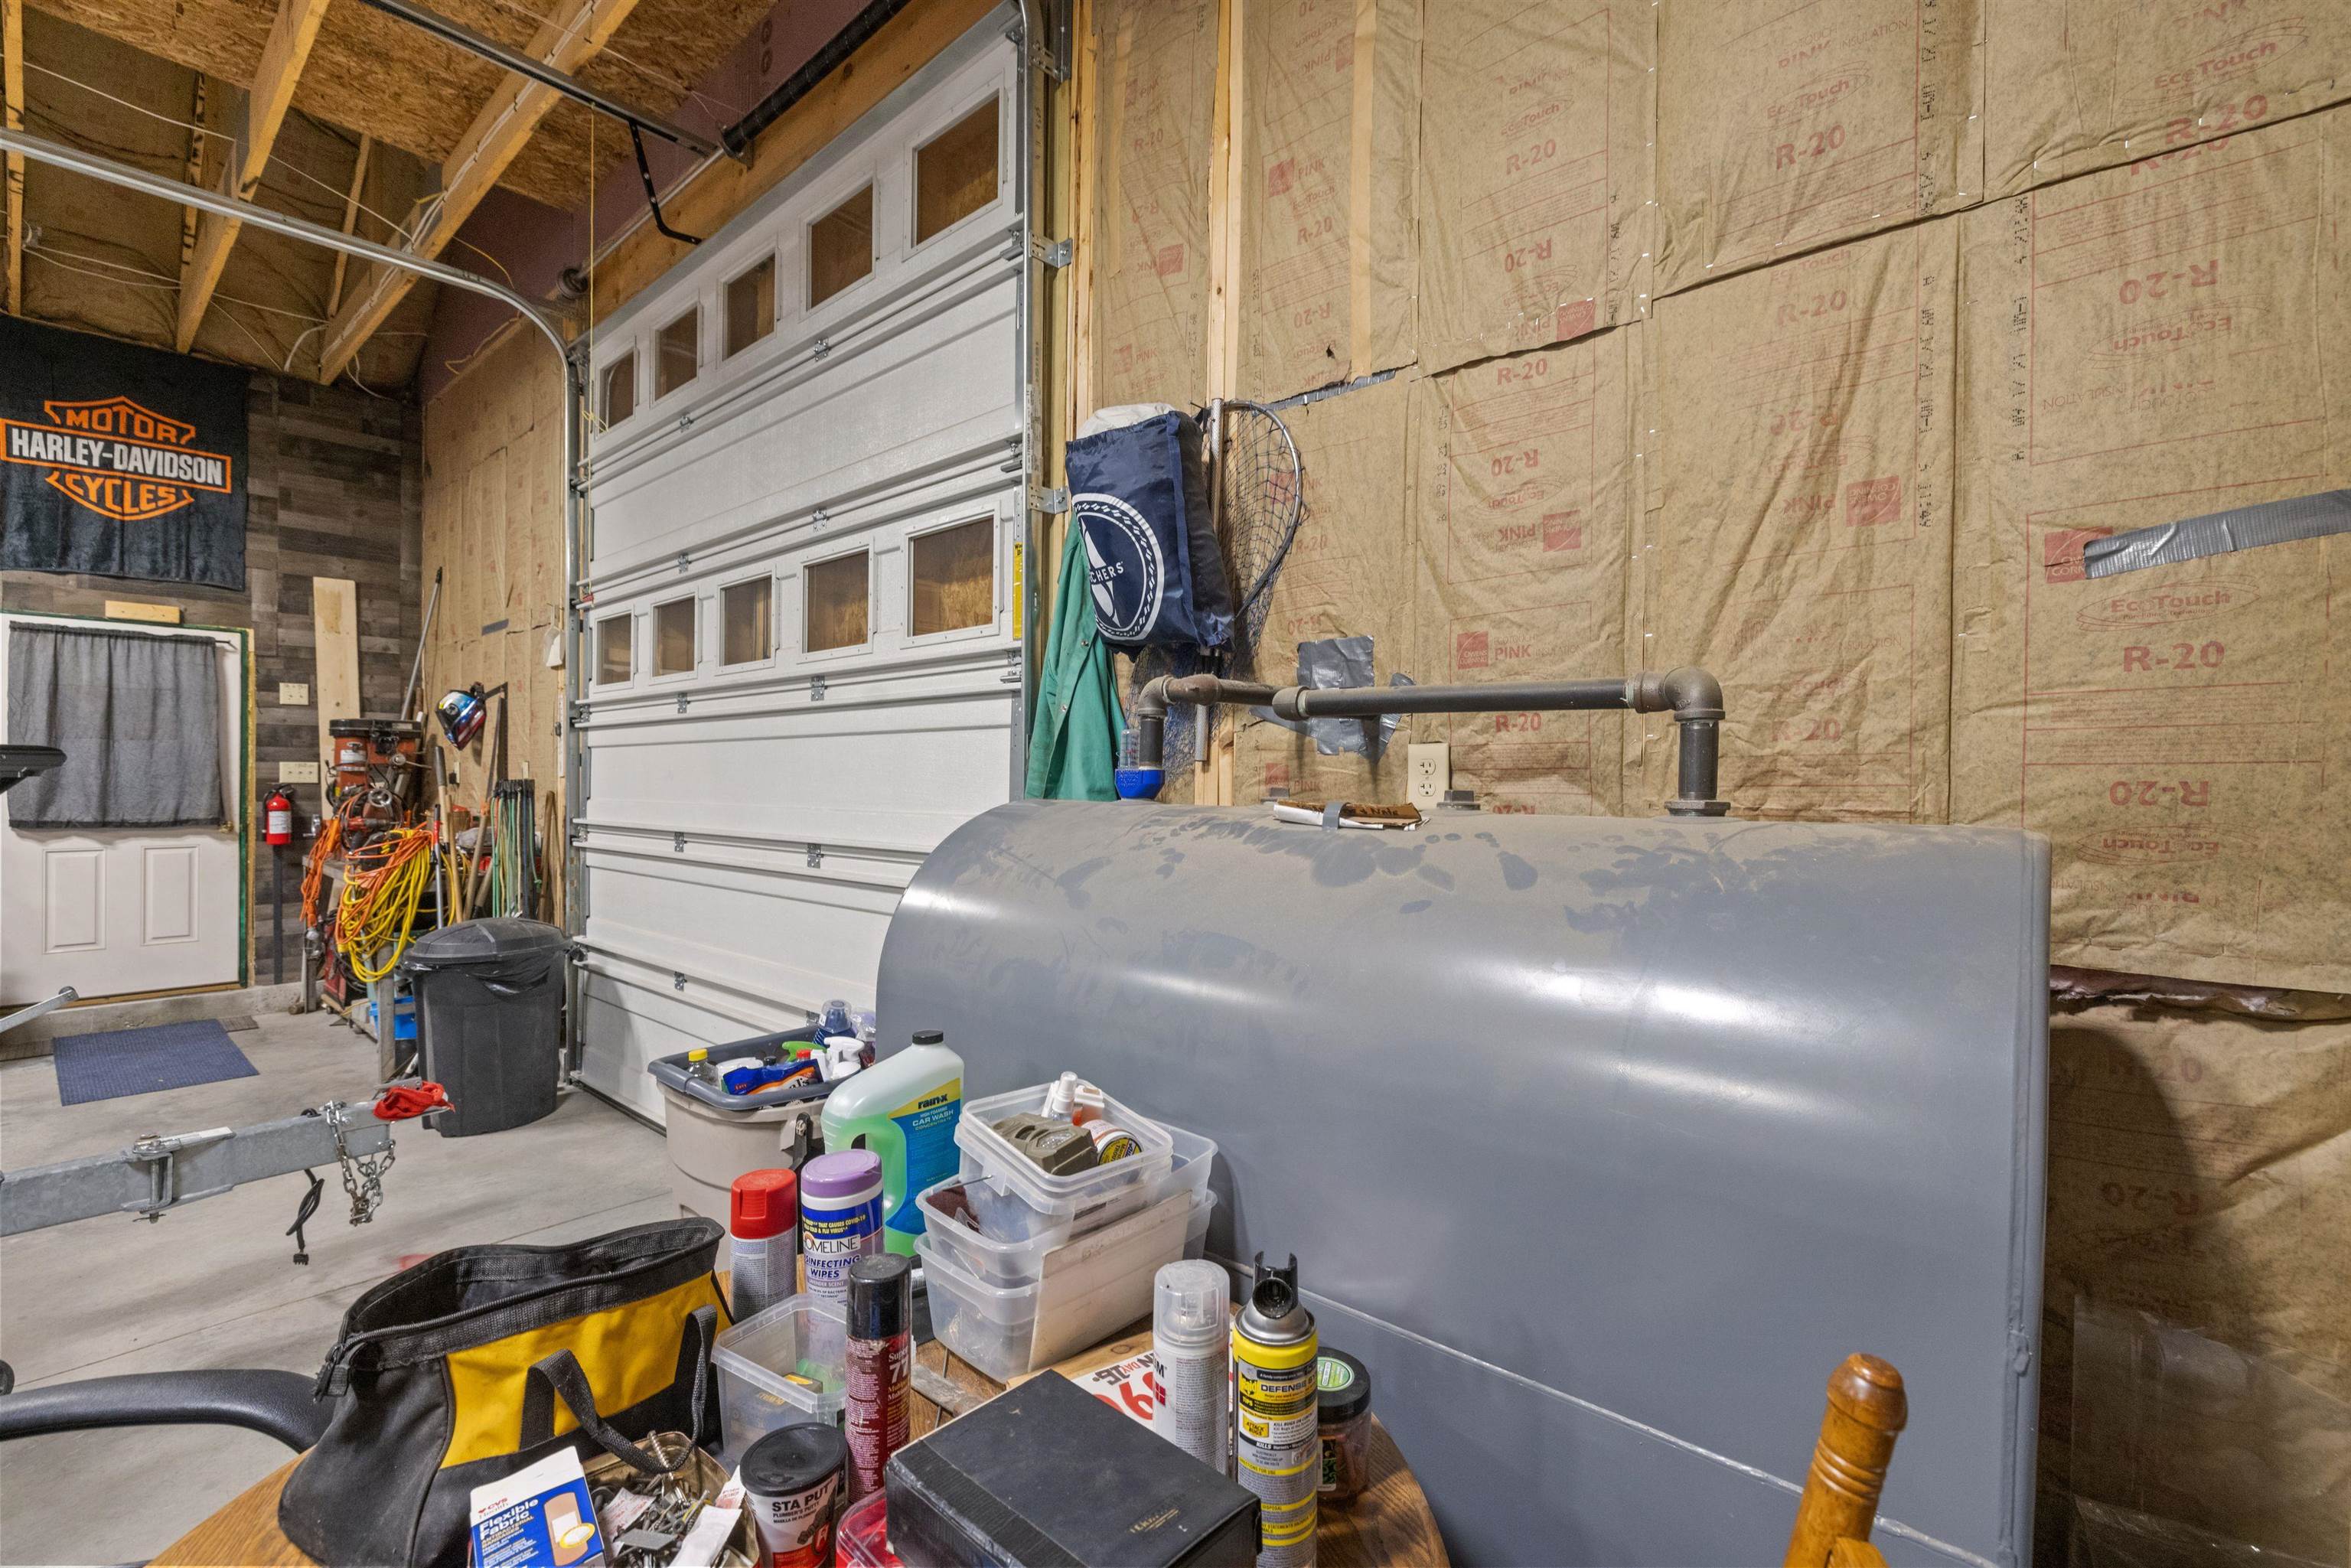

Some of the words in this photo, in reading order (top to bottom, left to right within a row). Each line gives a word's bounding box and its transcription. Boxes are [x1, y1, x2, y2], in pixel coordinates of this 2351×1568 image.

[2154, 42, 2278, 90] EcoTouch
[2165, 94, 2268, 144] R-20
[1506, 139, 1556, 175] R-20
[1776, 125, 1846, 170] R-20
[1296, 217, 1332, 246] R-20
[1505, 238, 1552, 273] R-20
[2118, 259, 2219, 305] R-20
[1294, 302, 1330, 328] R-20
[1777, 290, 1847, 327] R-20
[2114, 317, 2232, 351] EcoTouch
[1497, 358, 1547, 386] R-20
[66, 405, 177, 442] MOTOR
[11, 428, 222, 485] HARLEY-DAVIDSON
[1492, 449, 1538, 477] R-20
[65, 473, 176, 514] CYCLES
[1498, 523, 1535, 541] PINK
[1089, 562, 1123, 583] CHERS
[2111, 591, 2231, 613] EcoTouch
[1495, 644, 1531, 660] PINK
[2123, 641, 2225, 673] R-20
[1495, 712, 1542, 733] R-20
[1772, 716, 1841, 742] R-20
[2109, 781, 2209, 807] R-20
[2102, 838, 2219, 858] EcoTouch
[912, 1117, 931, 1126] CAR
[932, 1110, 954, 1121] WASH
[2098, 1182, 2201, 1216] R-20
[845, 1214, 866, 1224] COVID-19
[804, 1236, 859, 1253] OMELINE
[806, 1256, 860, 1268] SINFECTING
[810, 1268, 840, 1278] WIPES
[1121, 1362, 1141, 1374] DAY
[1247, 1422, 1264, 1432] ATTACK
[1249, 1428, 1262, 1436] BUGS
[487, 1498, 507, 1509] CVS
[772, 1500, 801, 1512] STA
[804, 1479, 833, 1506] PUT
[479, 1499, 538, 1531] Flexible
[773, 1508, 804, 1518] PLUMBER'S
[804, 1501, 820, 1512] PUTTY
[480, 1511, 530, 1540] Fabric
